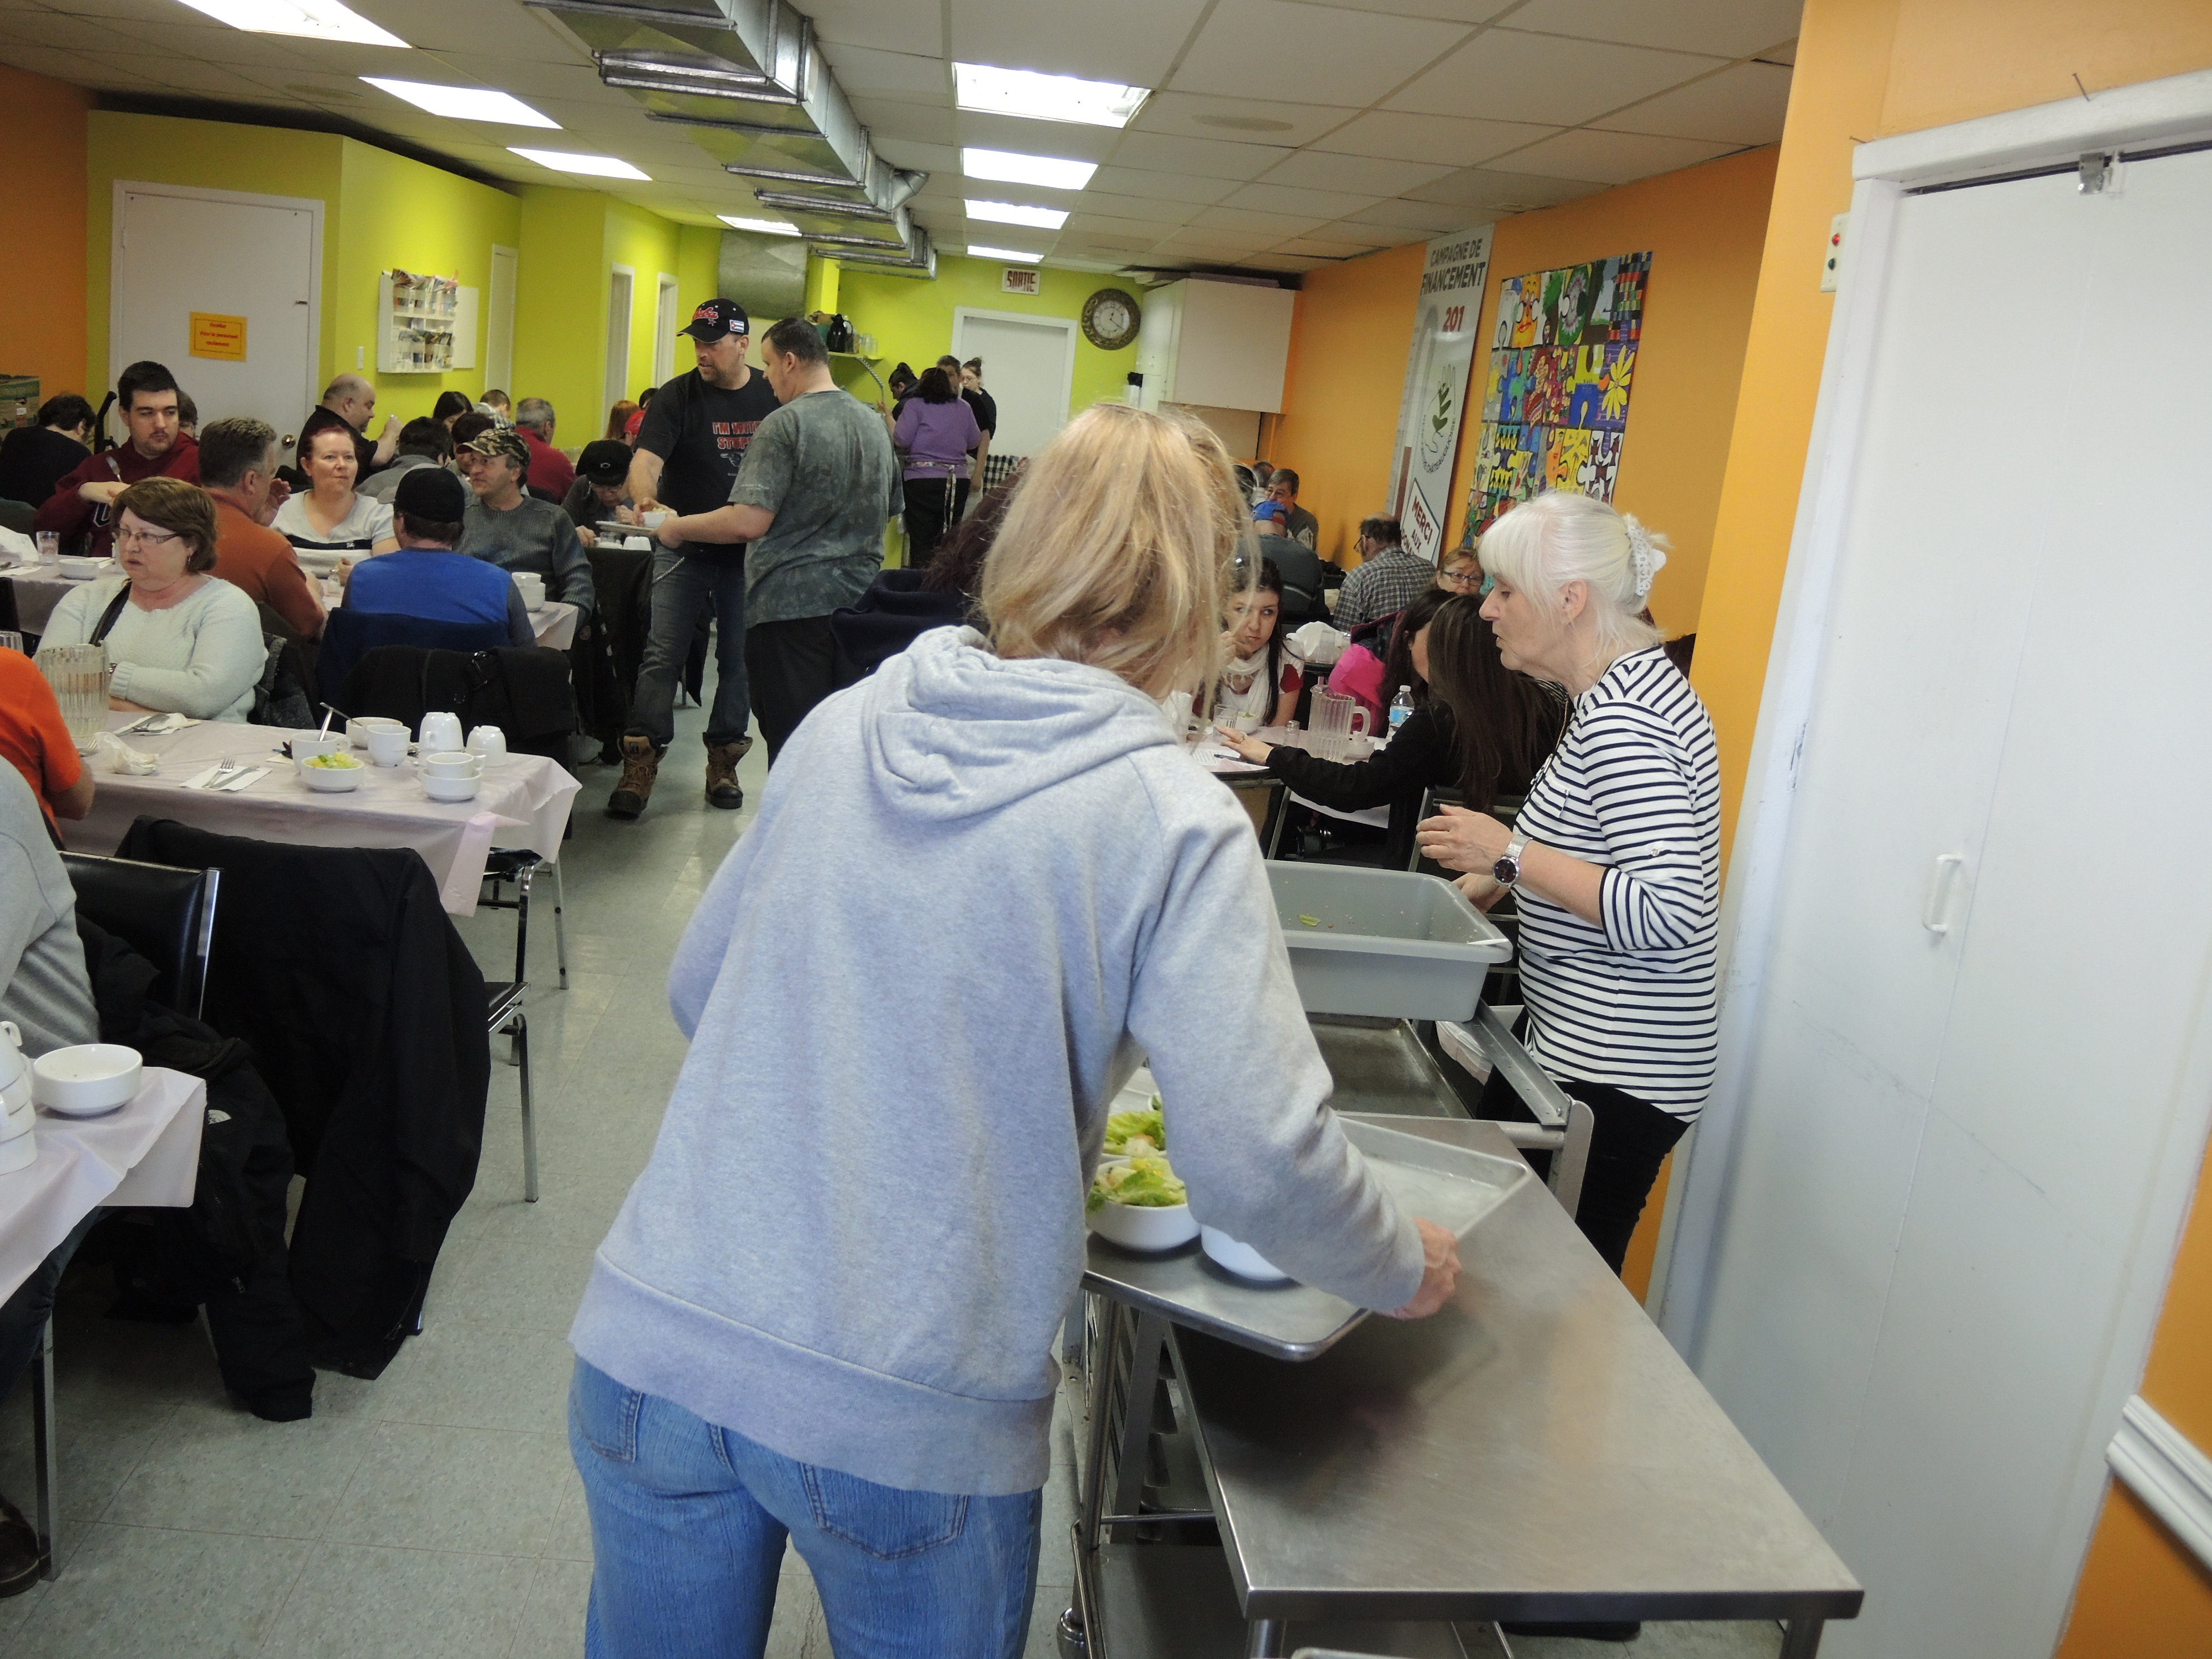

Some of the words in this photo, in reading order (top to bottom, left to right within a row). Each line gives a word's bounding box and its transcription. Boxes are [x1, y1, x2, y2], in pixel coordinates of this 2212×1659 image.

[1430, 241, 1470, 268] CAMPAGNE
[1468, 238, 1483, 259] DE
[1007, 270, 1036, 292] SORTIE
[1420, 261, 1486, 296] FINANCEMENT
[1442, 305, 1465, 332] 201
[1411, 495, 1433, 546] MERCI
[1401, 528, 1415, 557] DONA
[1411, 529, 1422, 554] AUX
